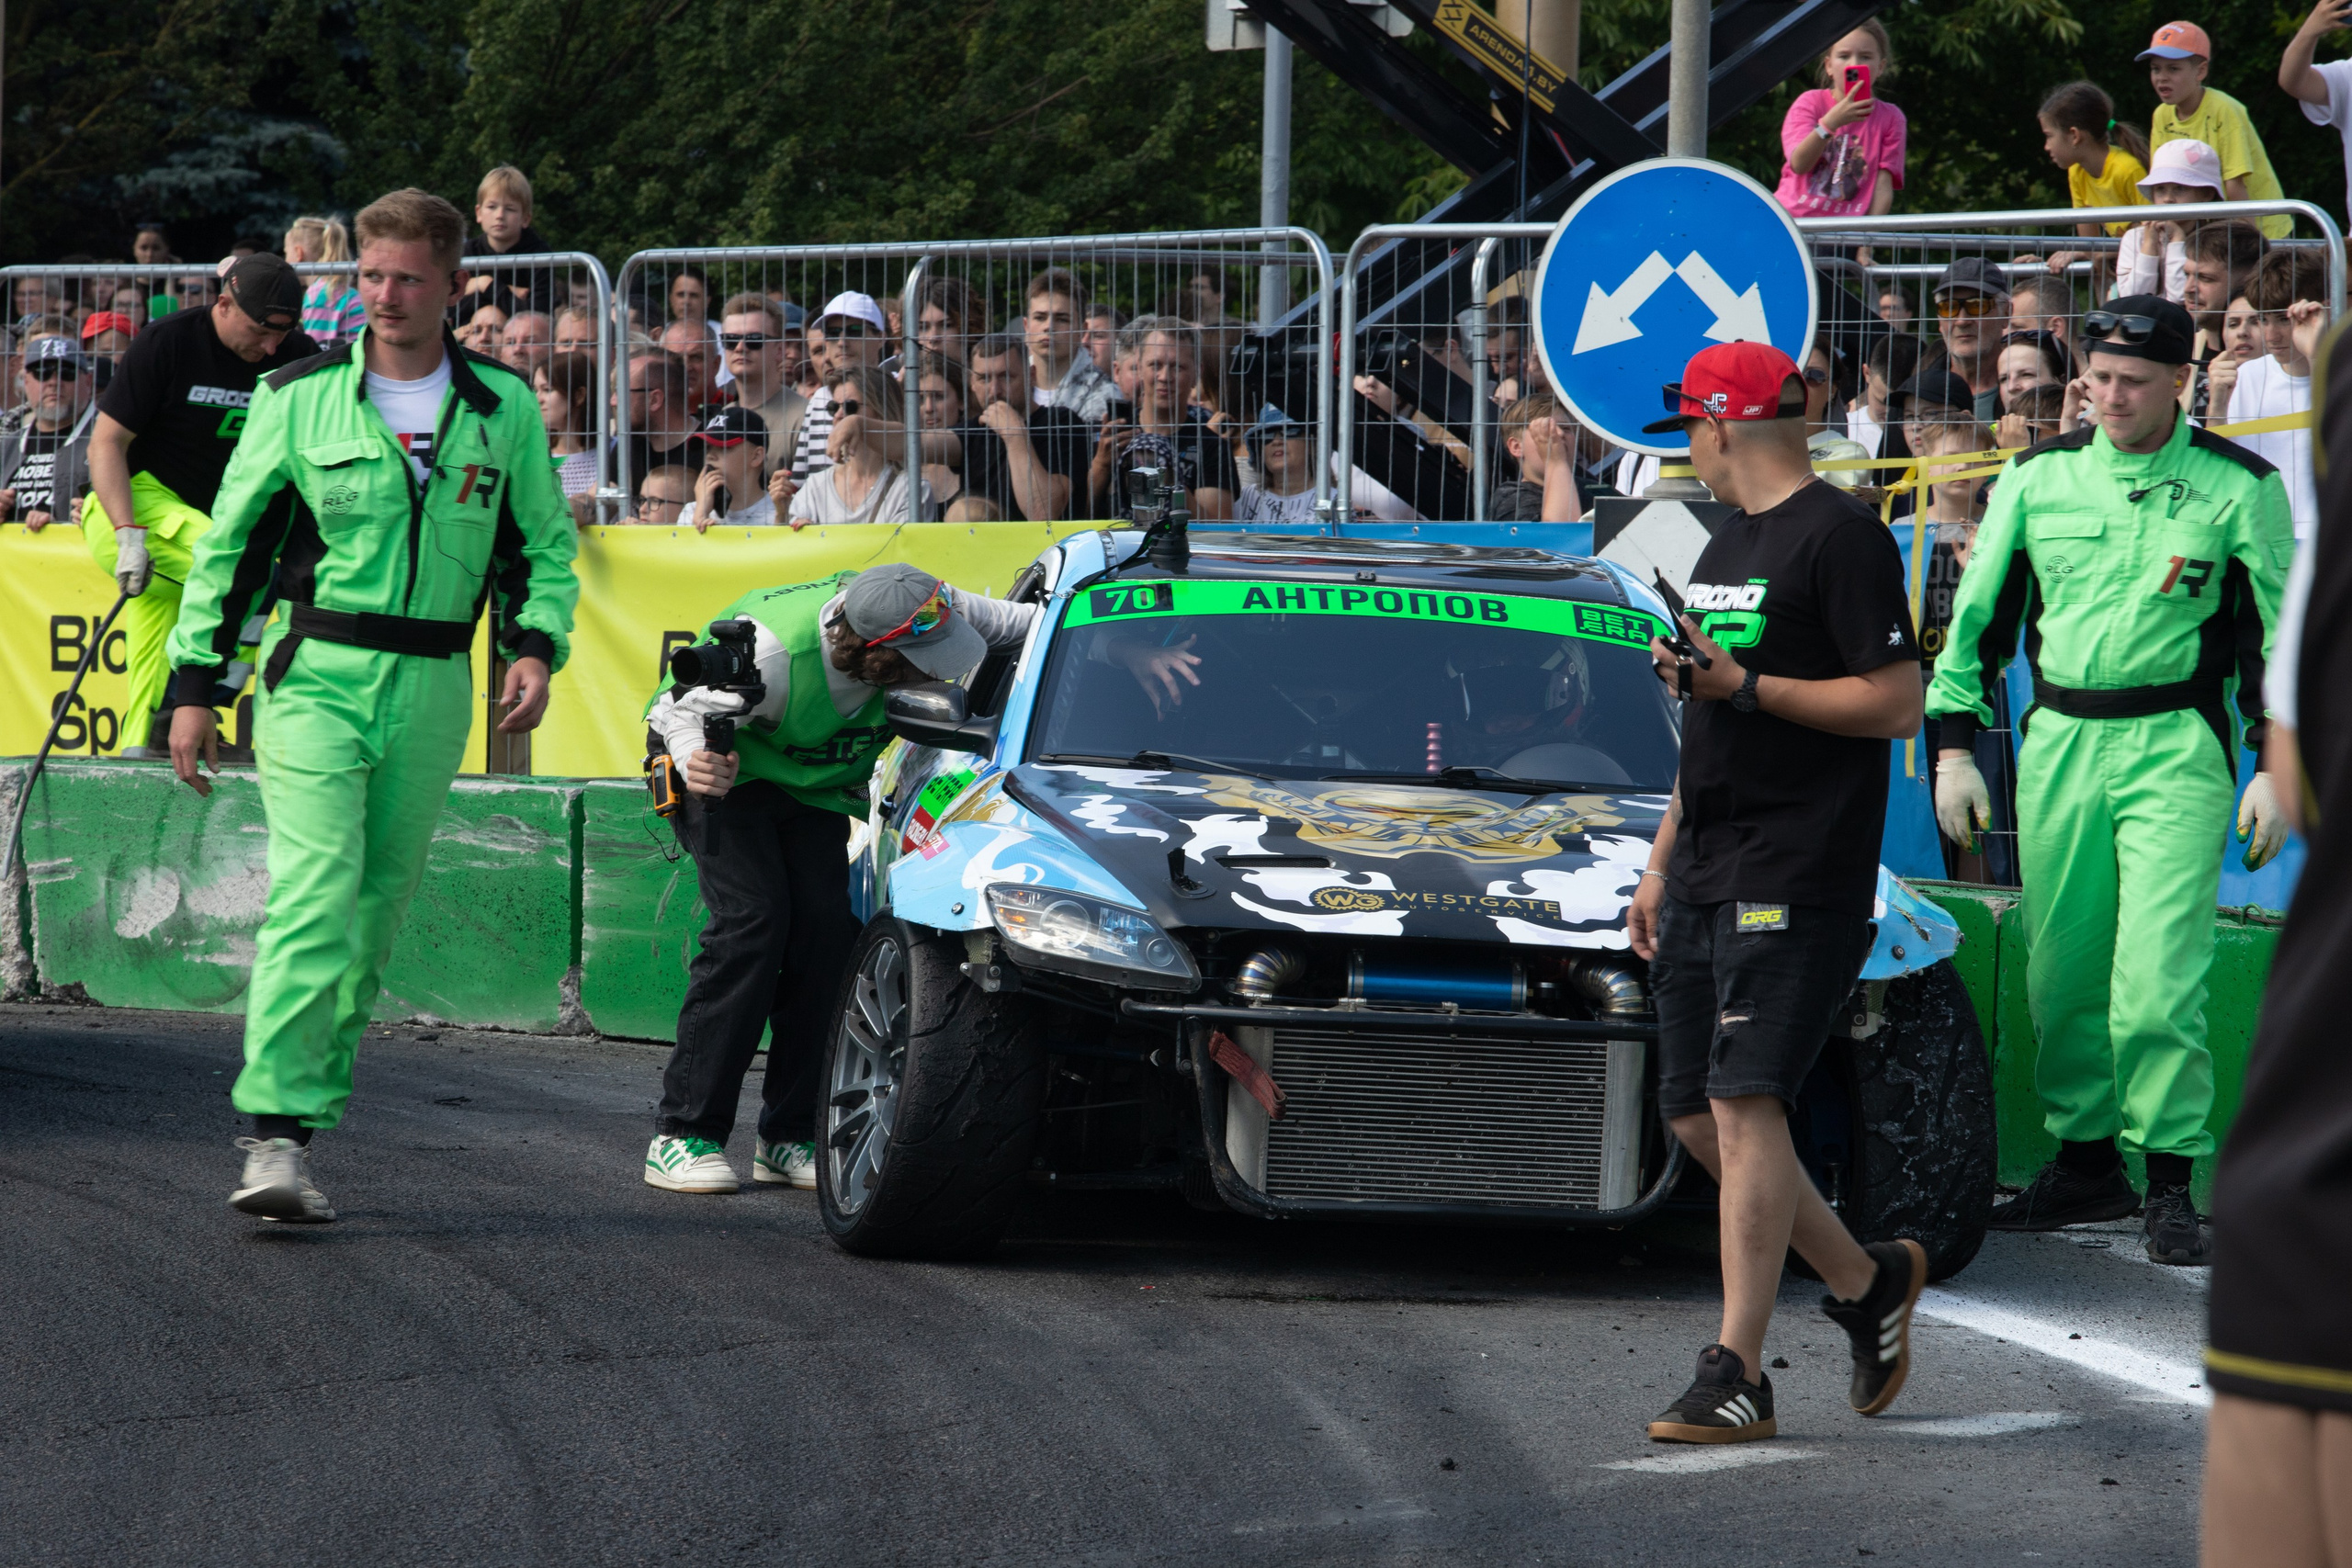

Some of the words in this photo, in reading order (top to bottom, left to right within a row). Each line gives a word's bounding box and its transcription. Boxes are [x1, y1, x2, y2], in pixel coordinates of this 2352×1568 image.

[1703, 392, 1727, 405] JP
[322, 491, 359, 507] RLG
[1105, 587, 1156, 613] 70
[1242, 586, 1509, 623] АНТРОПОВ
[1580, 609, 1645, 631] BET
[1391, 891, 1560, 913] WESTGATE
[1393, 904, 1560, 920] AUTOSERVICE
[1741, 910, 1782, 924] ORG
